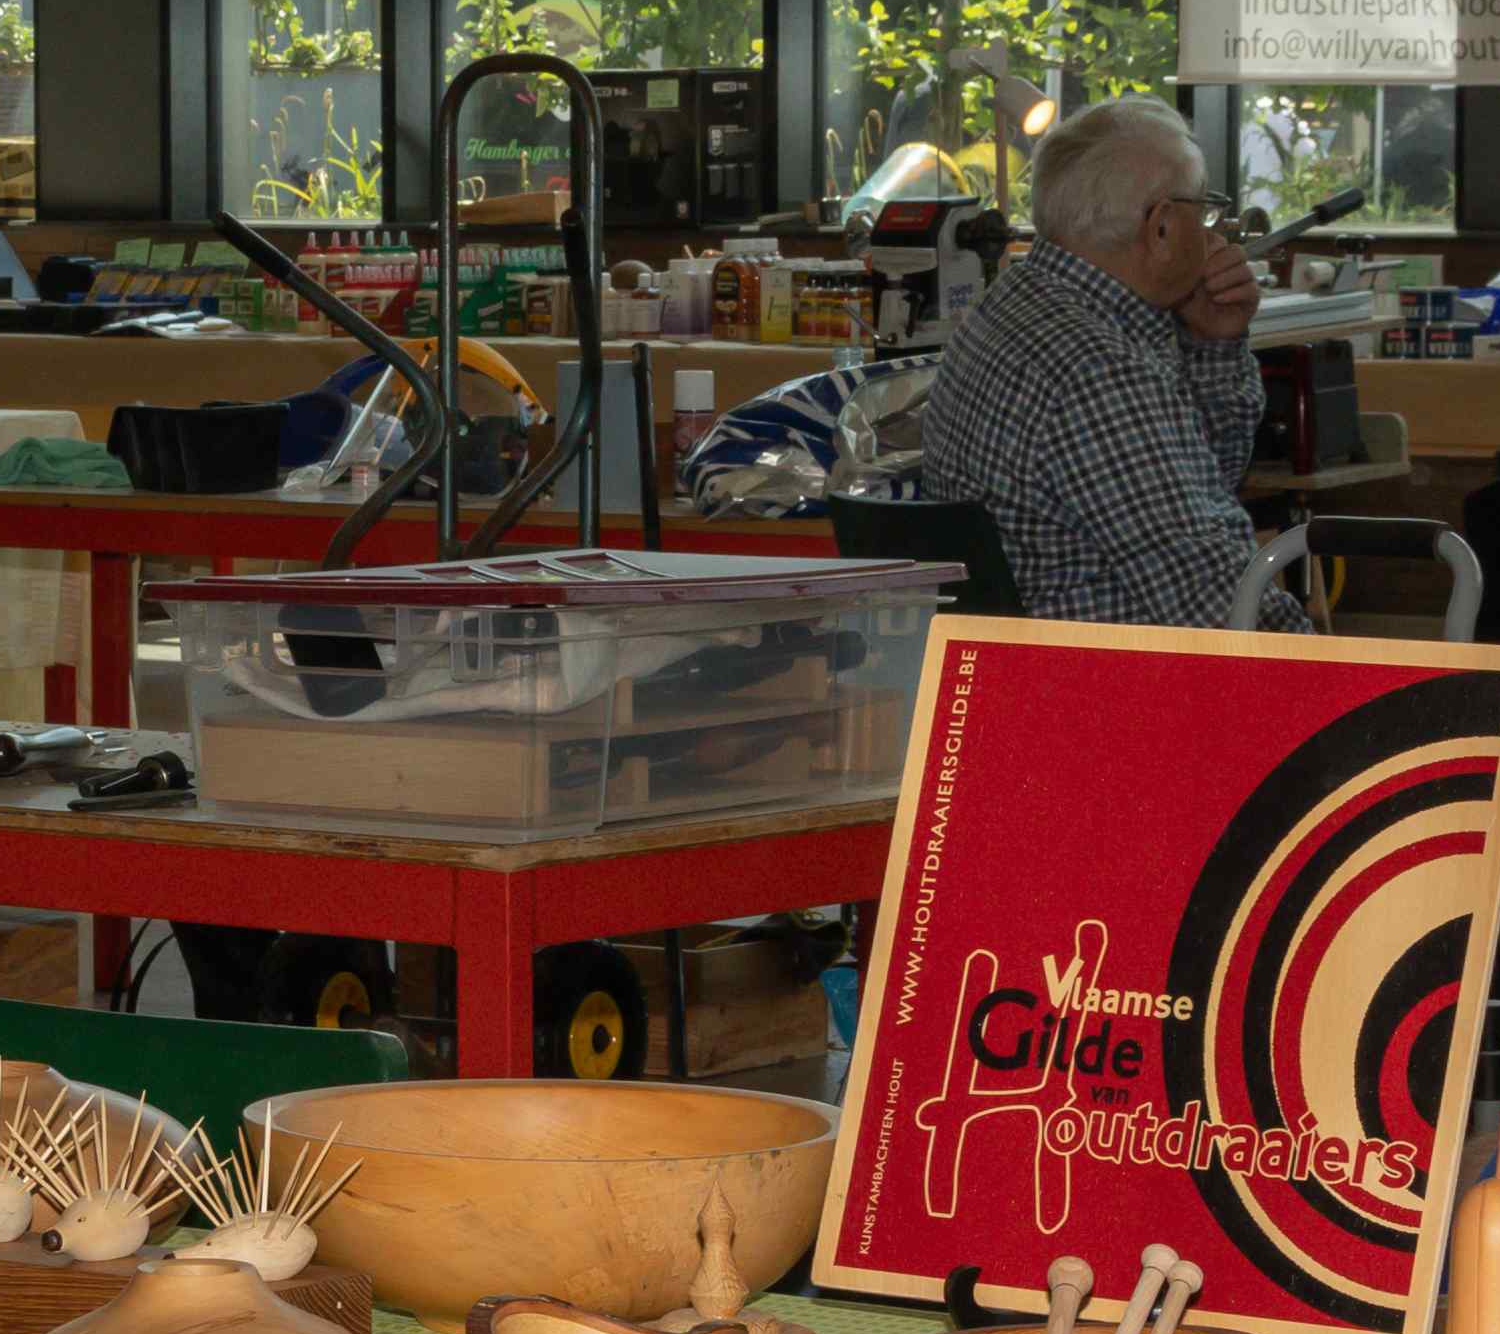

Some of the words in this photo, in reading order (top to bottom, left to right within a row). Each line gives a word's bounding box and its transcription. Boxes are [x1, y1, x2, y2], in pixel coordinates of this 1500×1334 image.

[895, 648, 978, 1025] WWW.HOUTDRAAIERSGILDE.BE
[1042, 953, 1194, 1022] Vlaamse
[969, 989, 1144, 1078] Gilde
[1090, 1084, 1130, 1105] van
[858, 1108, 897, 1256] KUNSTAMBACHTEN
[885, 1058, 906, 1105] HOUT
